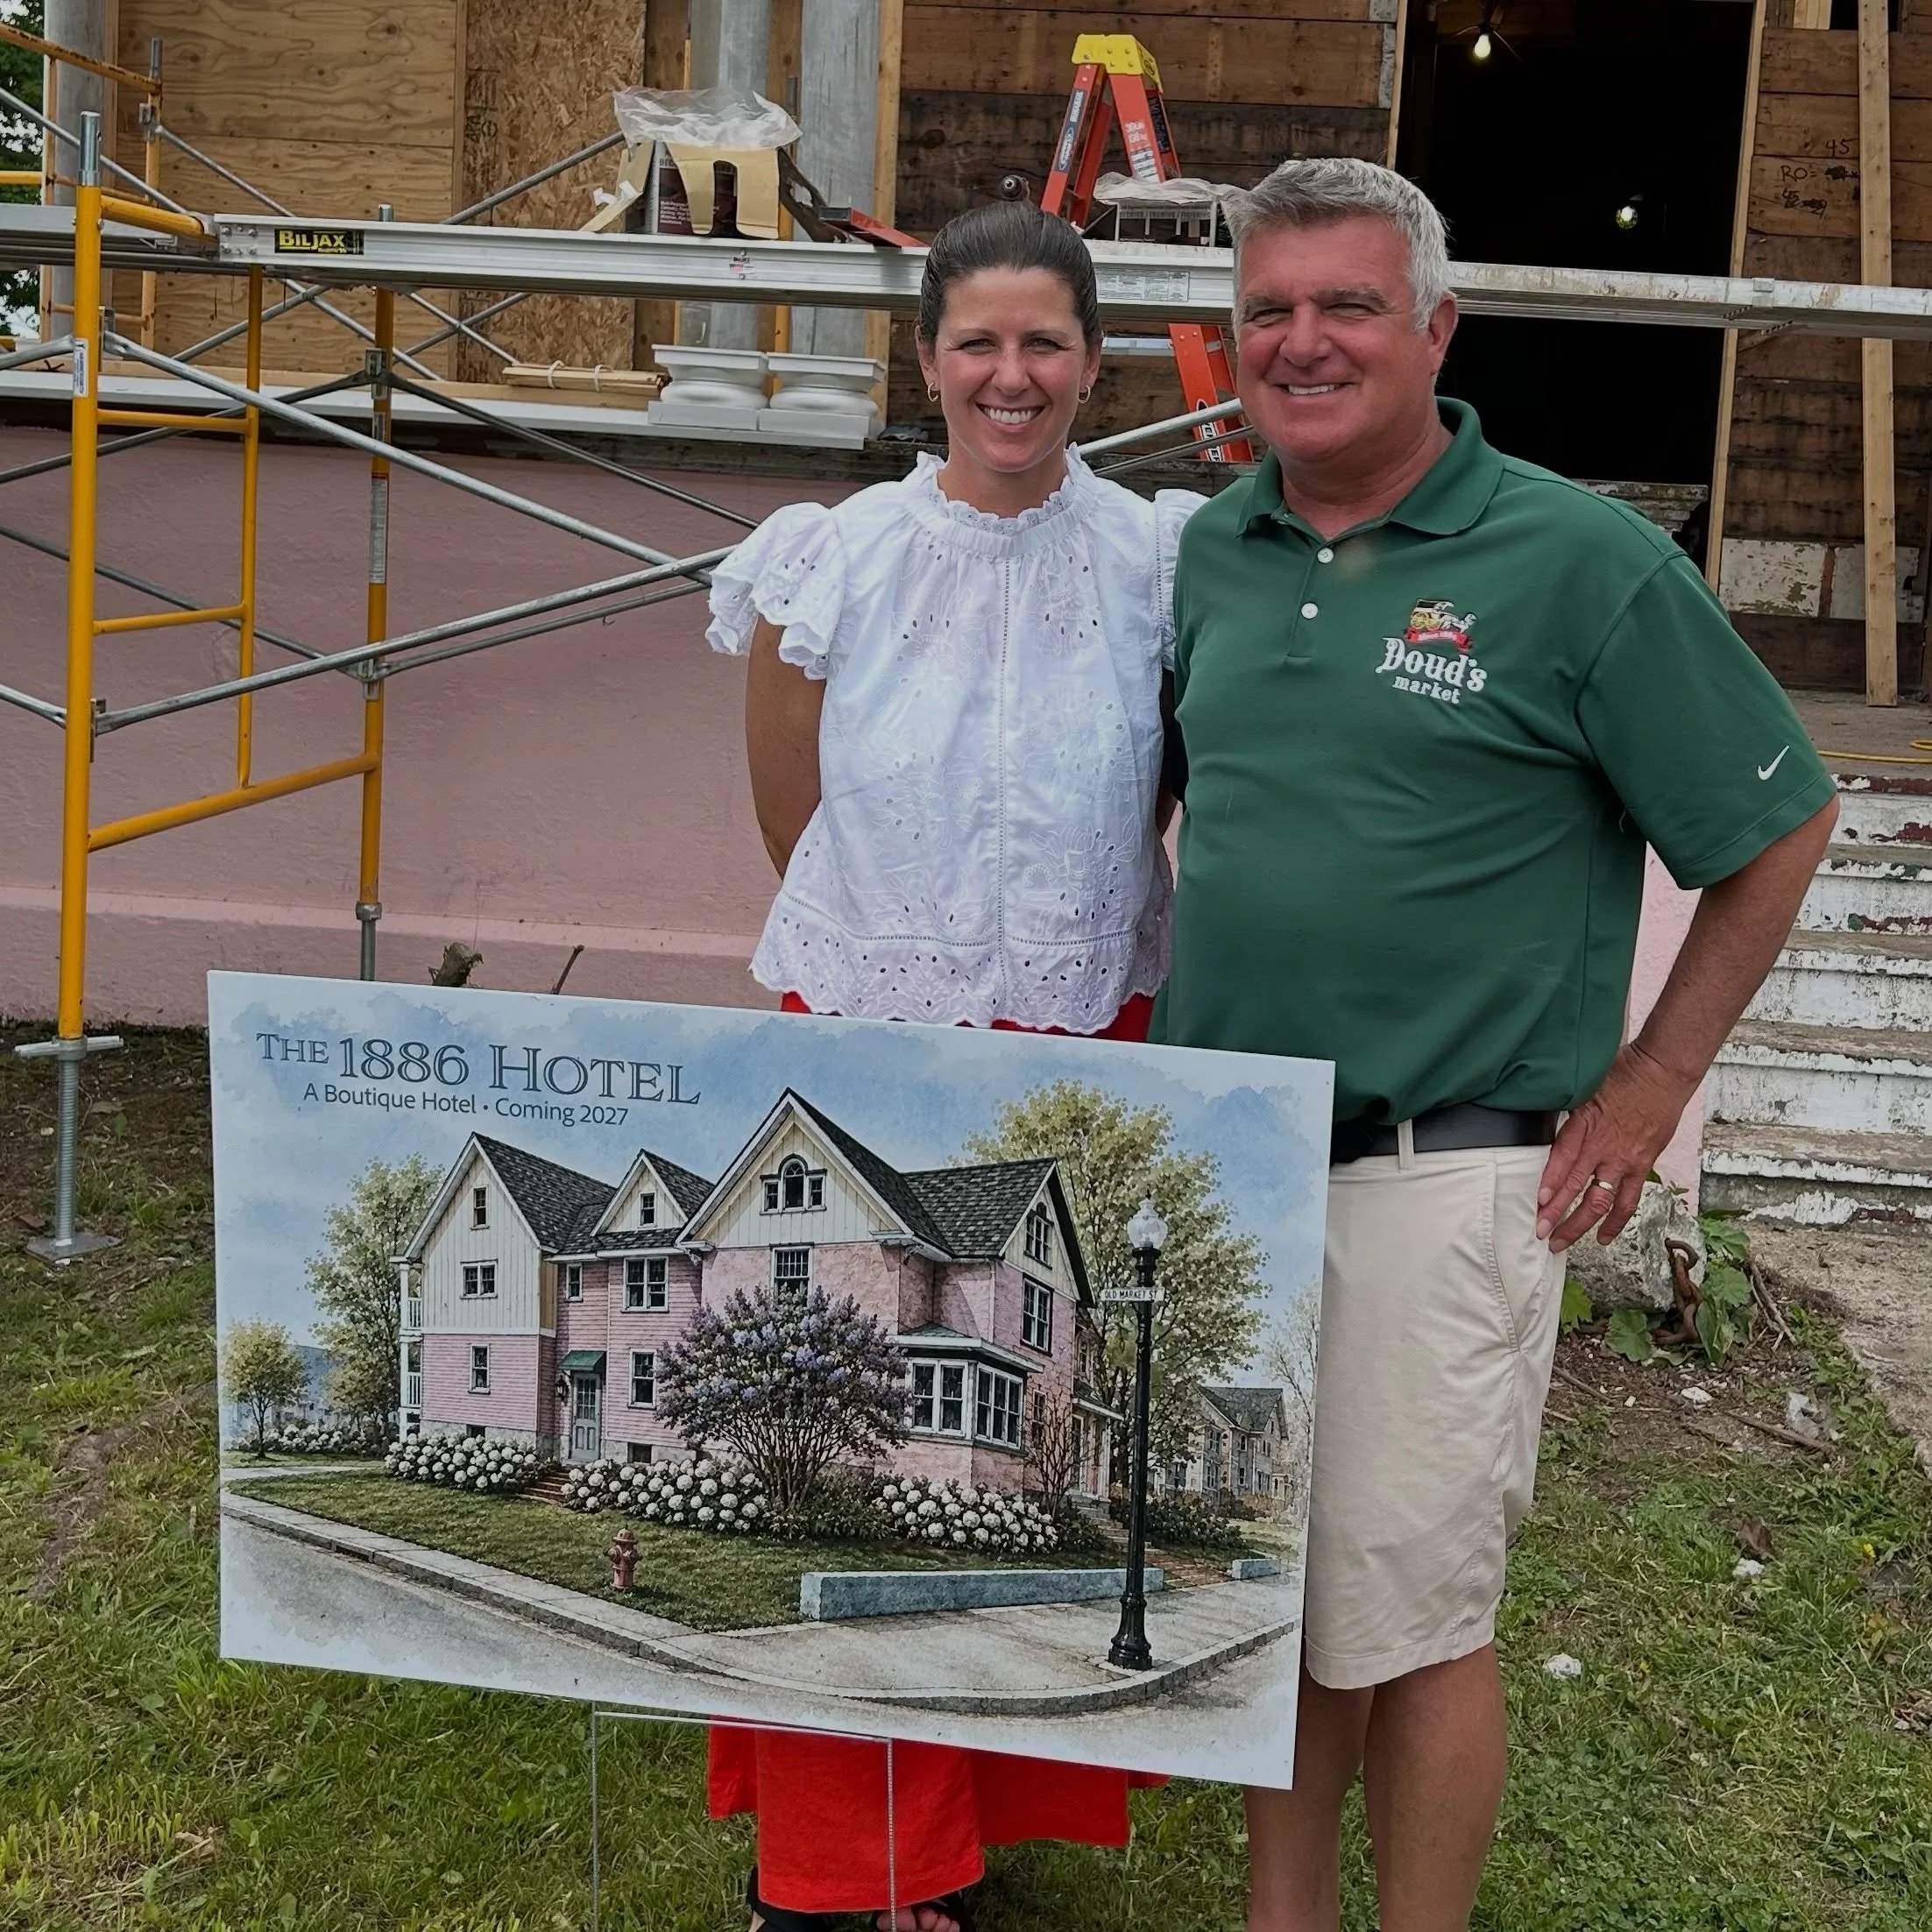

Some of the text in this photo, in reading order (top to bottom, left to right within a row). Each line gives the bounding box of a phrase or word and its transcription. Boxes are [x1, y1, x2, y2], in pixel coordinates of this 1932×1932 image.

[1375, 637, 1488, 692] Doud's
[1391, 676, 1461, 704] market
[256, 1032, 702, 1106] THE 1886 HOTEL
[302, 1082, 630, 1128] A Boutique Hotel Coming 2027
